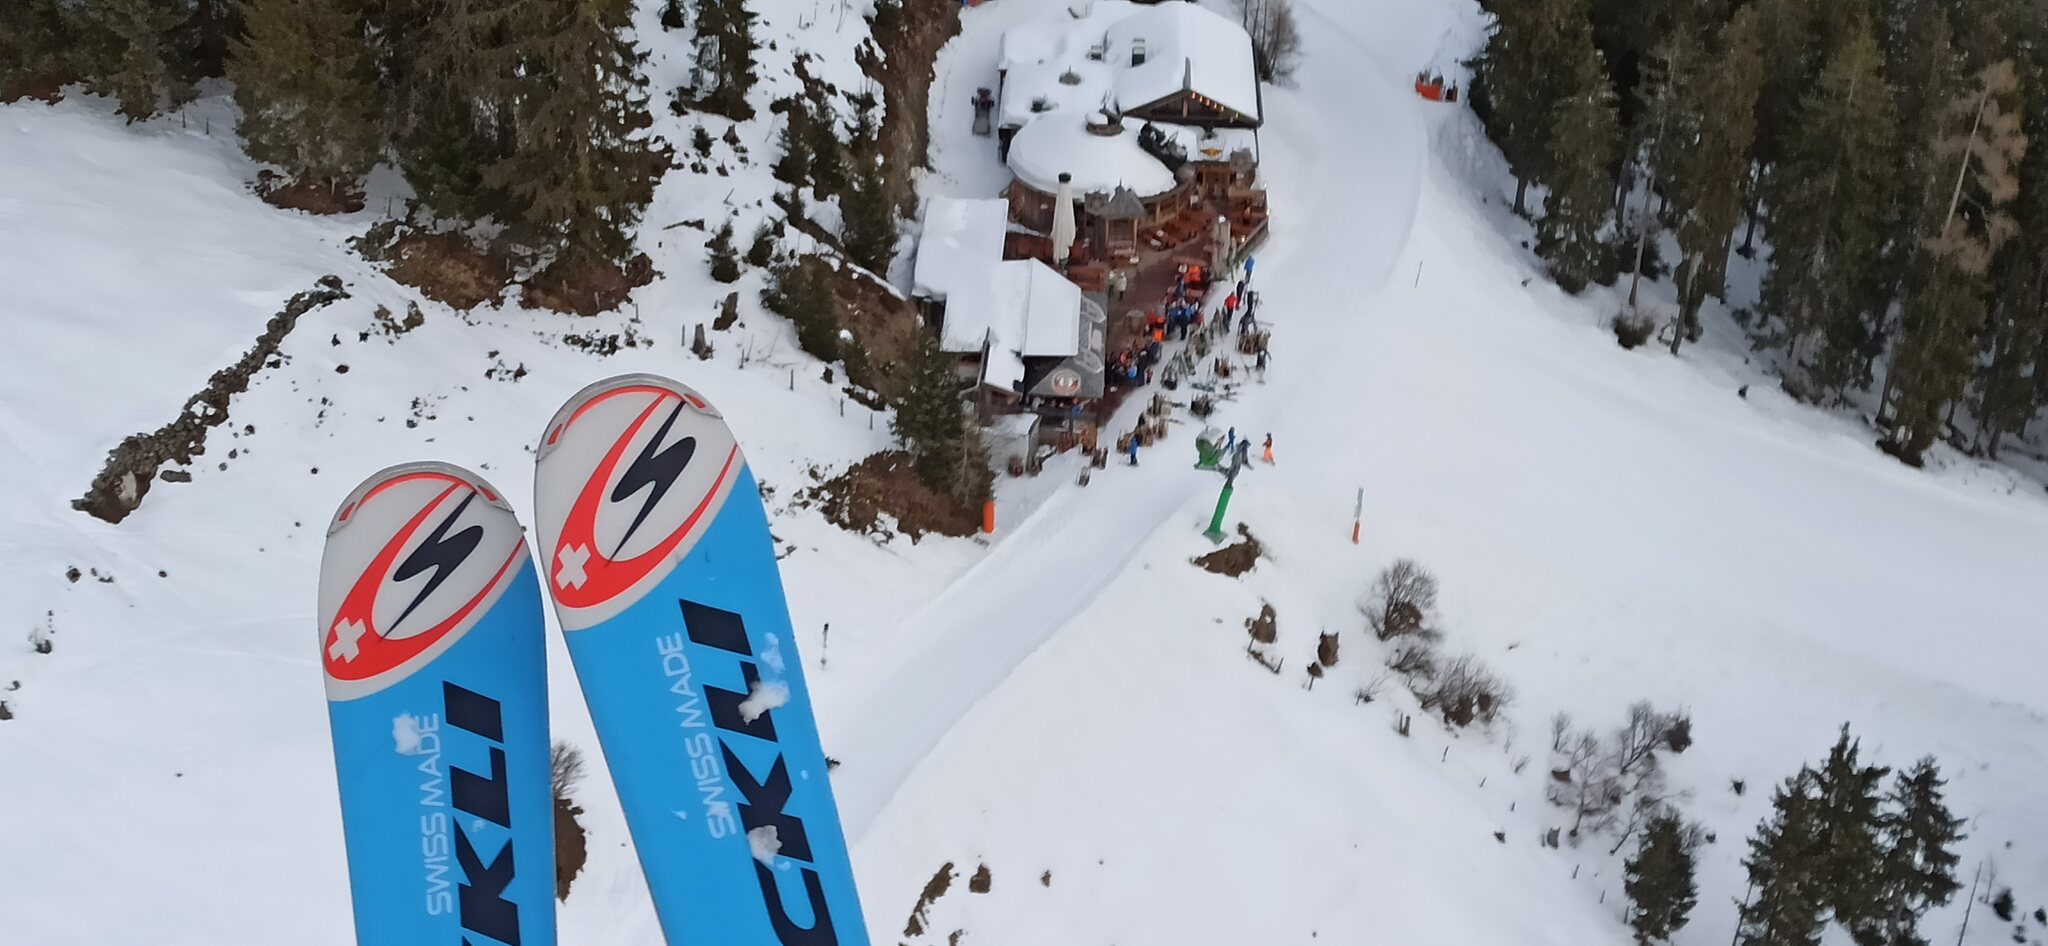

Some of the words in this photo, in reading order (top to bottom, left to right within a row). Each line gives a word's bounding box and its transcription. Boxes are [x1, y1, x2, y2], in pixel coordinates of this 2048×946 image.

[656, 631, 706, 728] MADE
[415, 712, 445, 807] MADE
[685, 732, 737, 839] SWISS
[420, 811, 453, 916] SWISS
[442, 680, 521, 946] KLI
